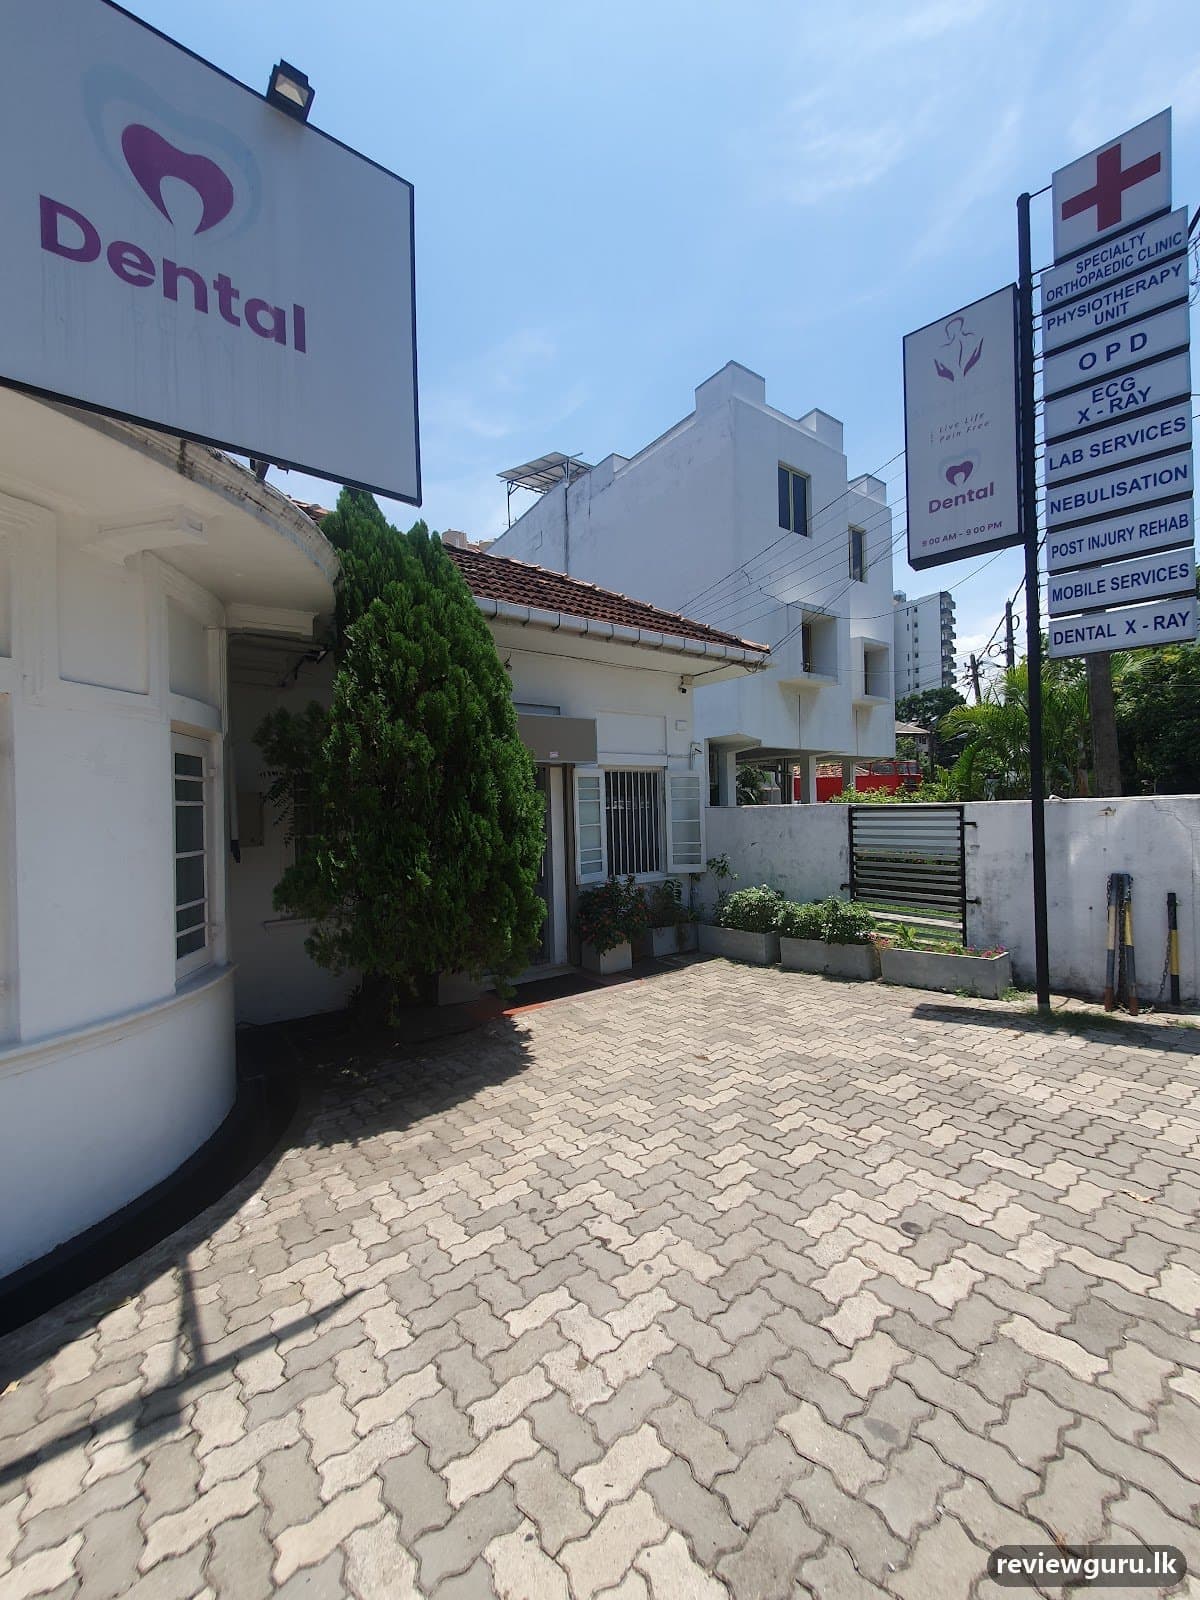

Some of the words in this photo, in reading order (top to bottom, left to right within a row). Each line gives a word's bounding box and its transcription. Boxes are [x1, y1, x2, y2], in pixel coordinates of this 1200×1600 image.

[39, 193, 306, 354] Dental
[1046, 254, 1134, 302] ORTHOPAEDIC
[1138, 231, 1182, 261] CLINIC
[1076, 232, 1146, 274] SPECIALTY
[1047, 263, 1183, 330] PHYSIOTHERAPY
[1094, 301, 1130, 326] UNIT
[1092, 376, 1136, 403] ECG
[1049, 448, 1084, 471] LAB
[1089, 416, 1186, 458] SERVICES
[928, 482, 994, 514] Dental
[1050, 464, 1188, 515] NEBULISATION
[942, 532, 957, 543] AM
[987, 521, 1003, 531] PM
[1051, 538, 1084, 559] POST
[1088, 526, 1135, 550] INJURY
[1139, 513, 1189, 539] REHAB
[1052, 579, 1106, 602] MOBILE
[1111, 562, 1189, 592] SERVICES
[1053, 623, 1117, 645] DENTAL
